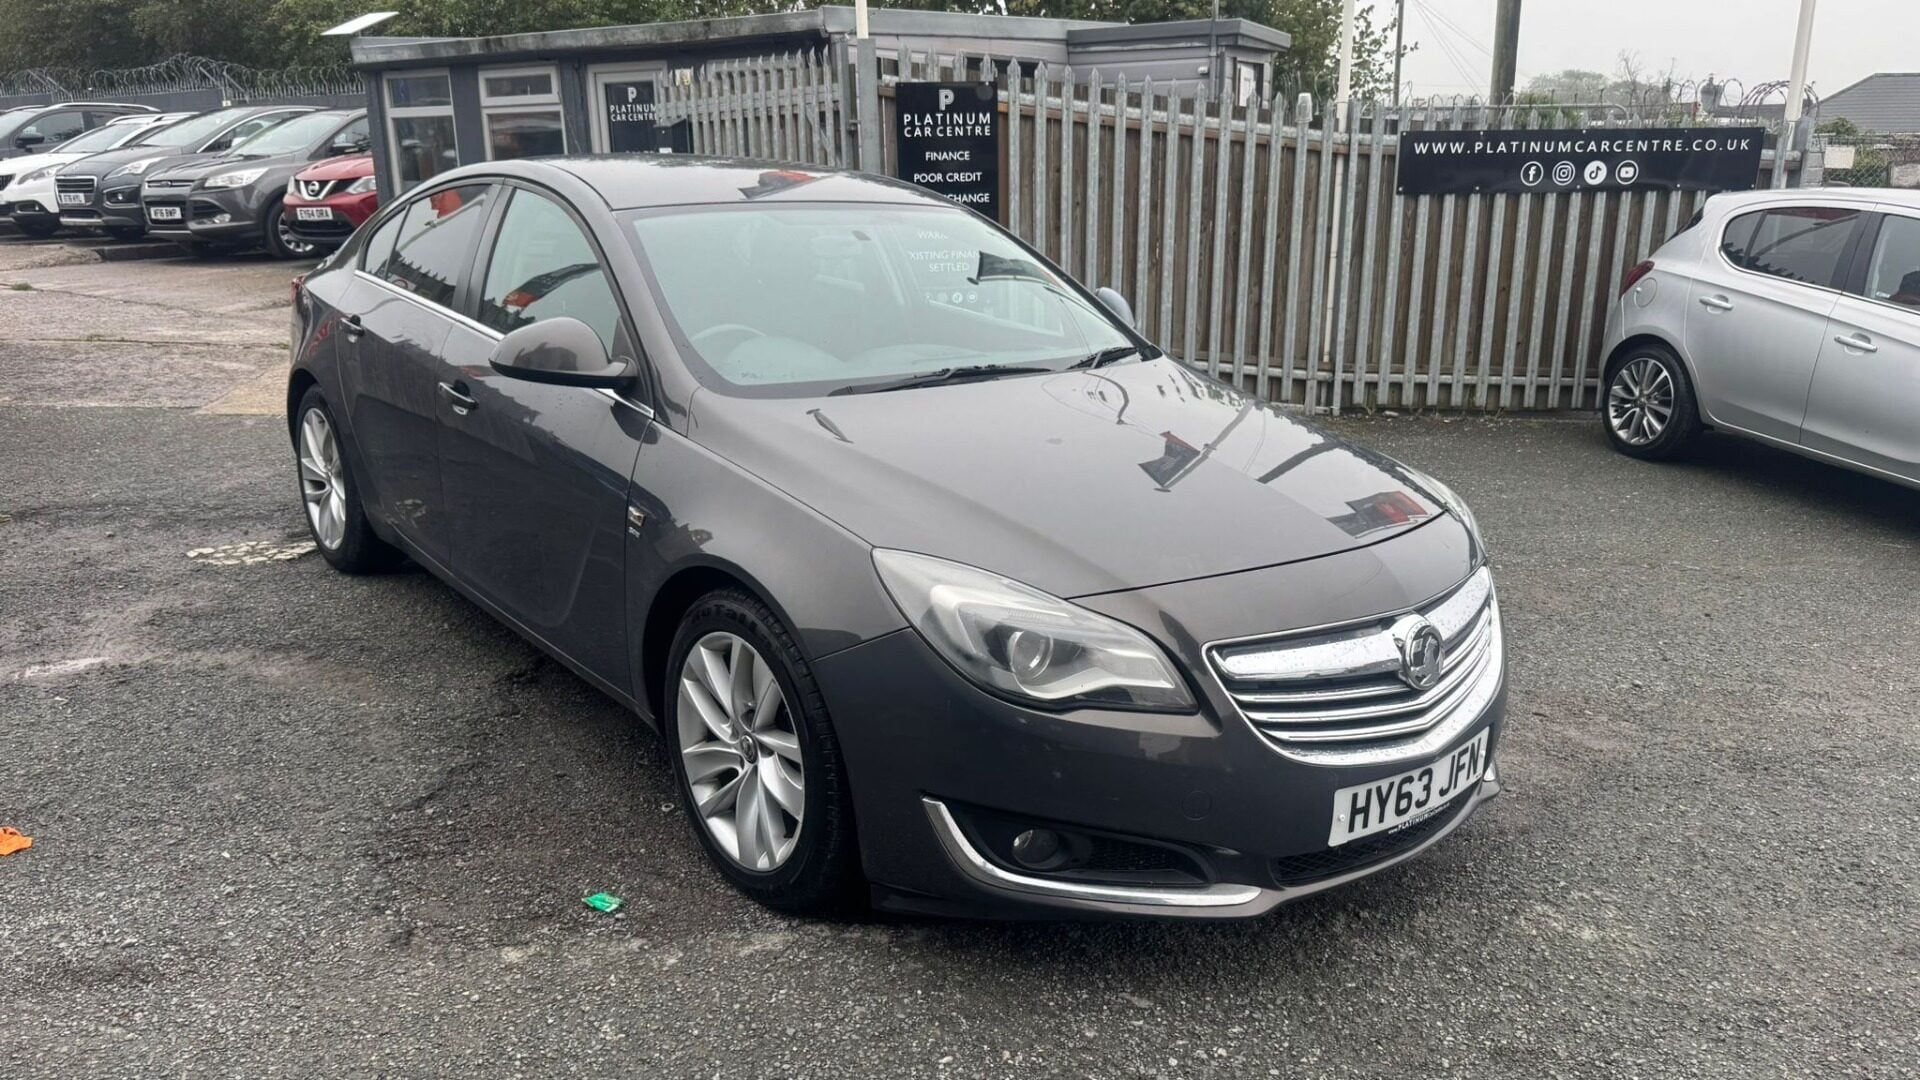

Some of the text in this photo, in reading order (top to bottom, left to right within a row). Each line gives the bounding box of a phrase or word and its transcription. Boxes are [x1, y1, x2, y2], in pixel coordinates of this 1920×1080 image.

[610, 104, 656, 113] PLATINUM
[611, 114, 626, 122] CAR
[903, 112, 991, 126] PLATINUM
[904, 125, 991, 138] CAR CENTRE
[1414, 138, 1751, 154] WWW.PLATINUMCARCENTRE.CO.UK
[925, 151, 970, 161] FINANCE
[913, 172, 982, 183] POOR CREDIT
[945, 192, 990, 204] CHANGE
[1348, 737, 1482, 833] HY63 JFN
